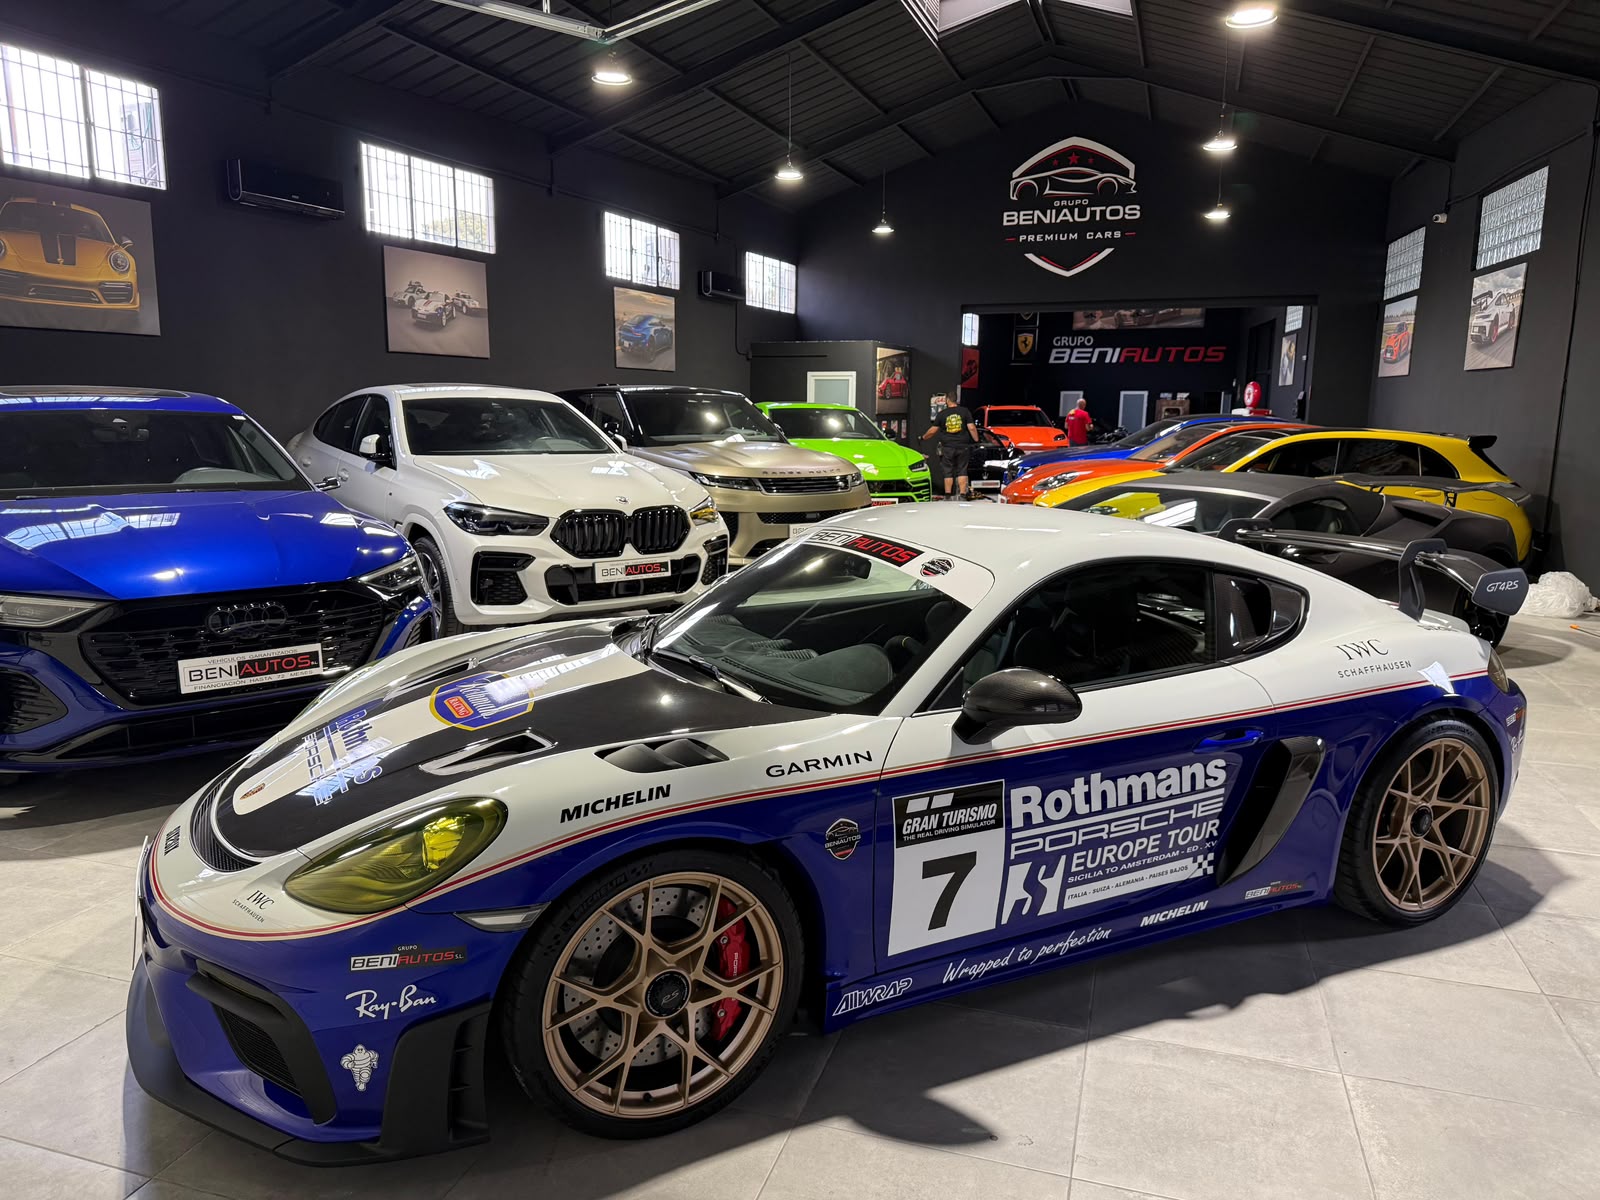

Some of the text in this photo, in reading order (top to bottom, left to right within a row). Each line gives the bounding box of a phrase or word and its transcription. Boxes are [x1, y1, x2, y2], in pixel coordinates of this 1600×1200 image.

[1003, 205, 1141, 226] BENIAUTOS
[1019, 230, 1122, 242] PREMIUM CARS
[1048, 346, 1227, 364] BENIAUTOS
[1053, 336, 1094, 347] GRUPO
[1335, 639, 1389, 660] IWC
[1337, 660, 1412, 678] SCHAFFHAUSEN
[765, 750, 873, 778] GARMIN
[559, 784, 672, 824] MICHELIN
[1010, 758, 1227, 829] Rothmans
[902, 803, 998, 835] GRAN TURISMO
[903, 834, 916, 842] THE
[934, 826, 960, 836] DRIVING
[960, 819, 996, 832] SIMULATOR
[1010, 796, 1224, 860] PORSCHE
[1070, 818, 1220, 873] EUROPE TOUR
[1067, 840, 1218, 883] SICILIA TO AMSTERDAM ED XV
[921, 850, 978, 931] 7
[1067, 890, 1088, 900] ITALIA
[1092, 885, 1111, 895] SUIZA
[1114, 876, 1145, 890] ALEMANIA
[1169, 865, 1188, 874] BAJOS
[232, 899, 264, 924] SCHAFFHAUSEN
[246, 890, 274, 910] IWC
[1140, 900, 1208, 927] MICHELIN
[352, 951, 455, 969] BENIAUTOS
[942, 927, 1112, 984] Wrapped to perfection
[345, 984, 436, 1020] Ray-Ban
